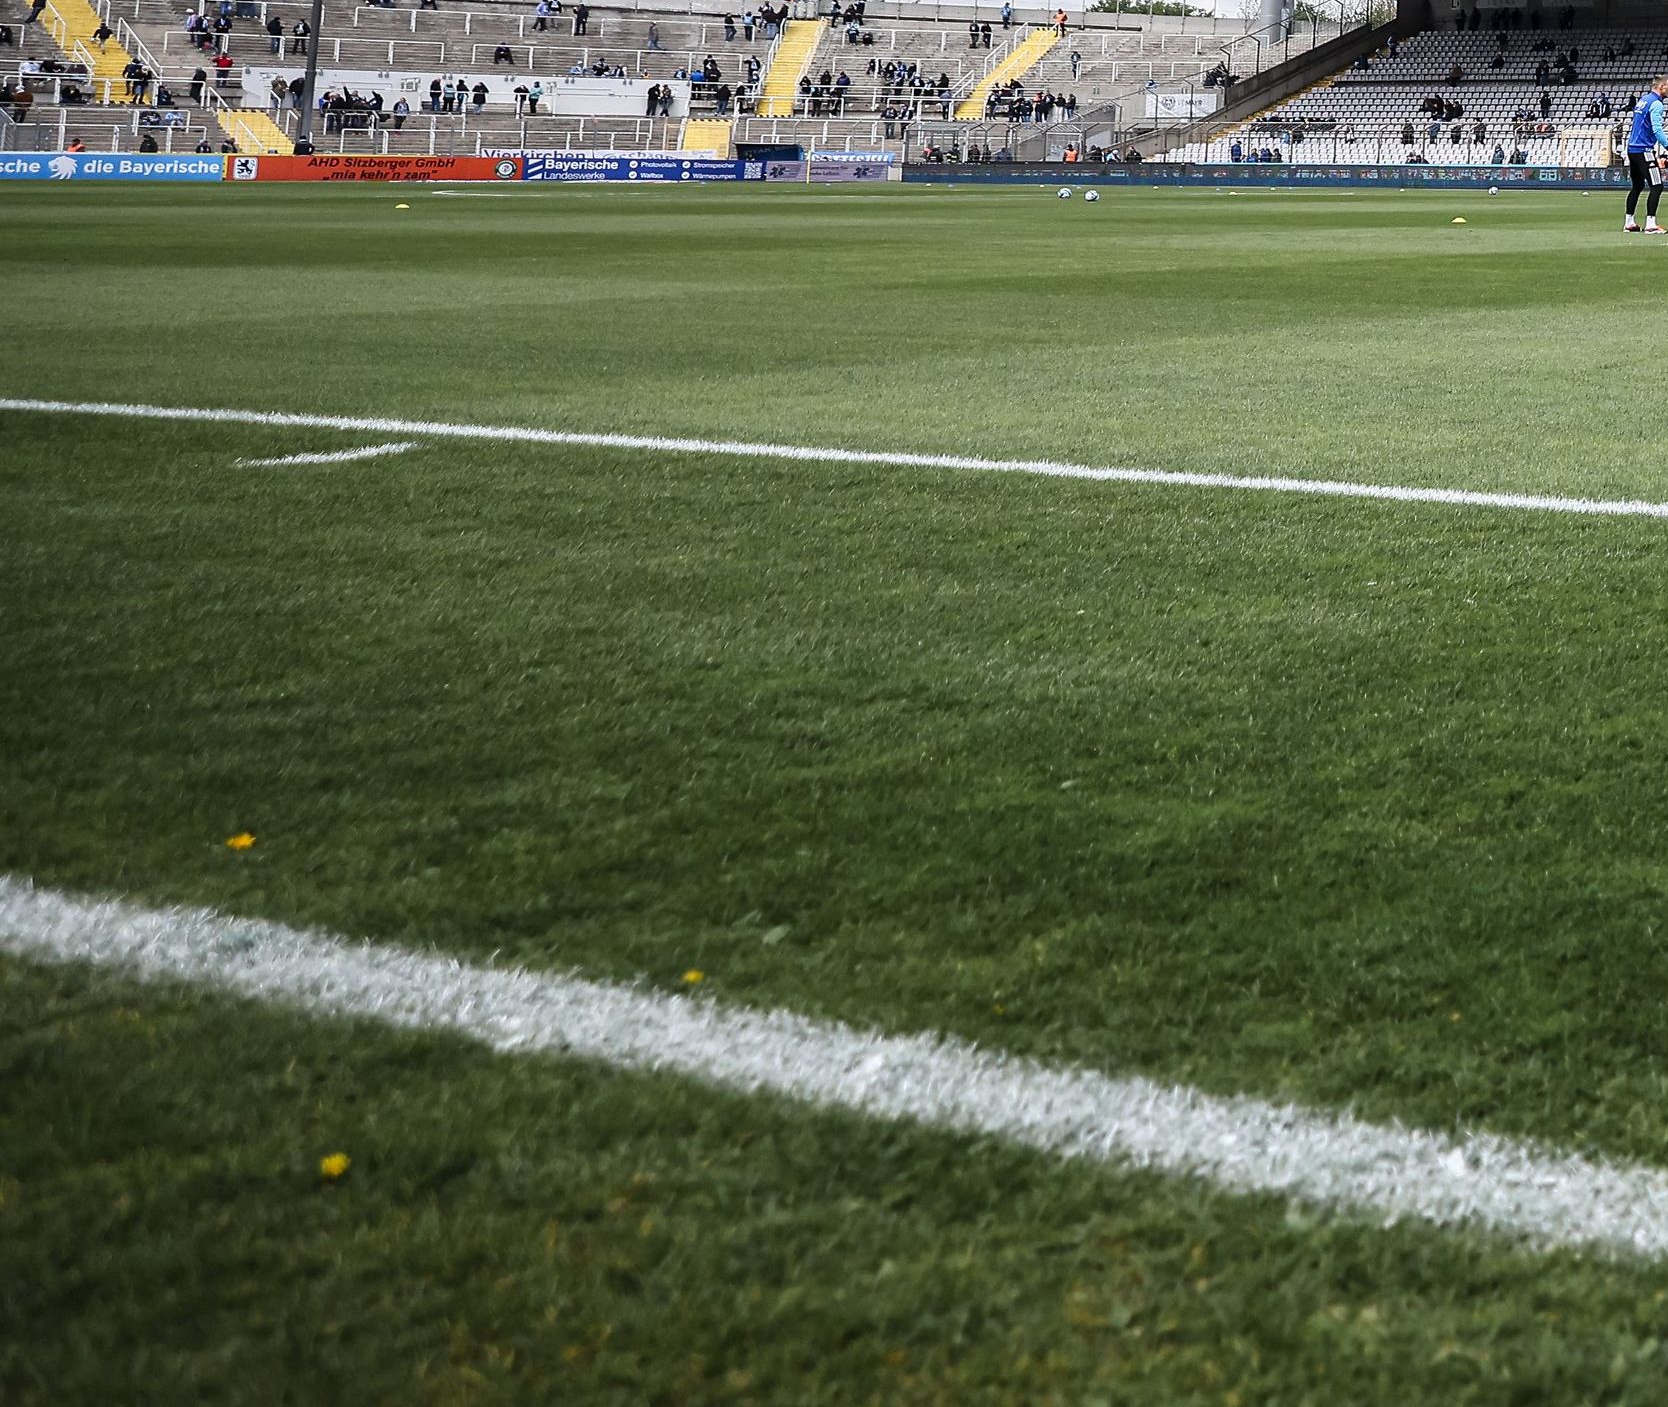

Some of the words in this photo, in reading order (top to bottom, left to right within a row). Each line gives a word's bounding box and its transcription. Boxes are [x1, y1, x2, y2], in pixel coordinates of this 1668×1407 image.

[83, 160, 113, 173] die
[120, 160, 220, 176] Bayerische
[308, 158, 340, 168] AHD
[344, 158, 412, 171] Sitzberger
[415, 158, 456, 168] GmbH
[545, 160, 619, 171] Bayerische
[544, 171, 605, 180] Landeswerke
